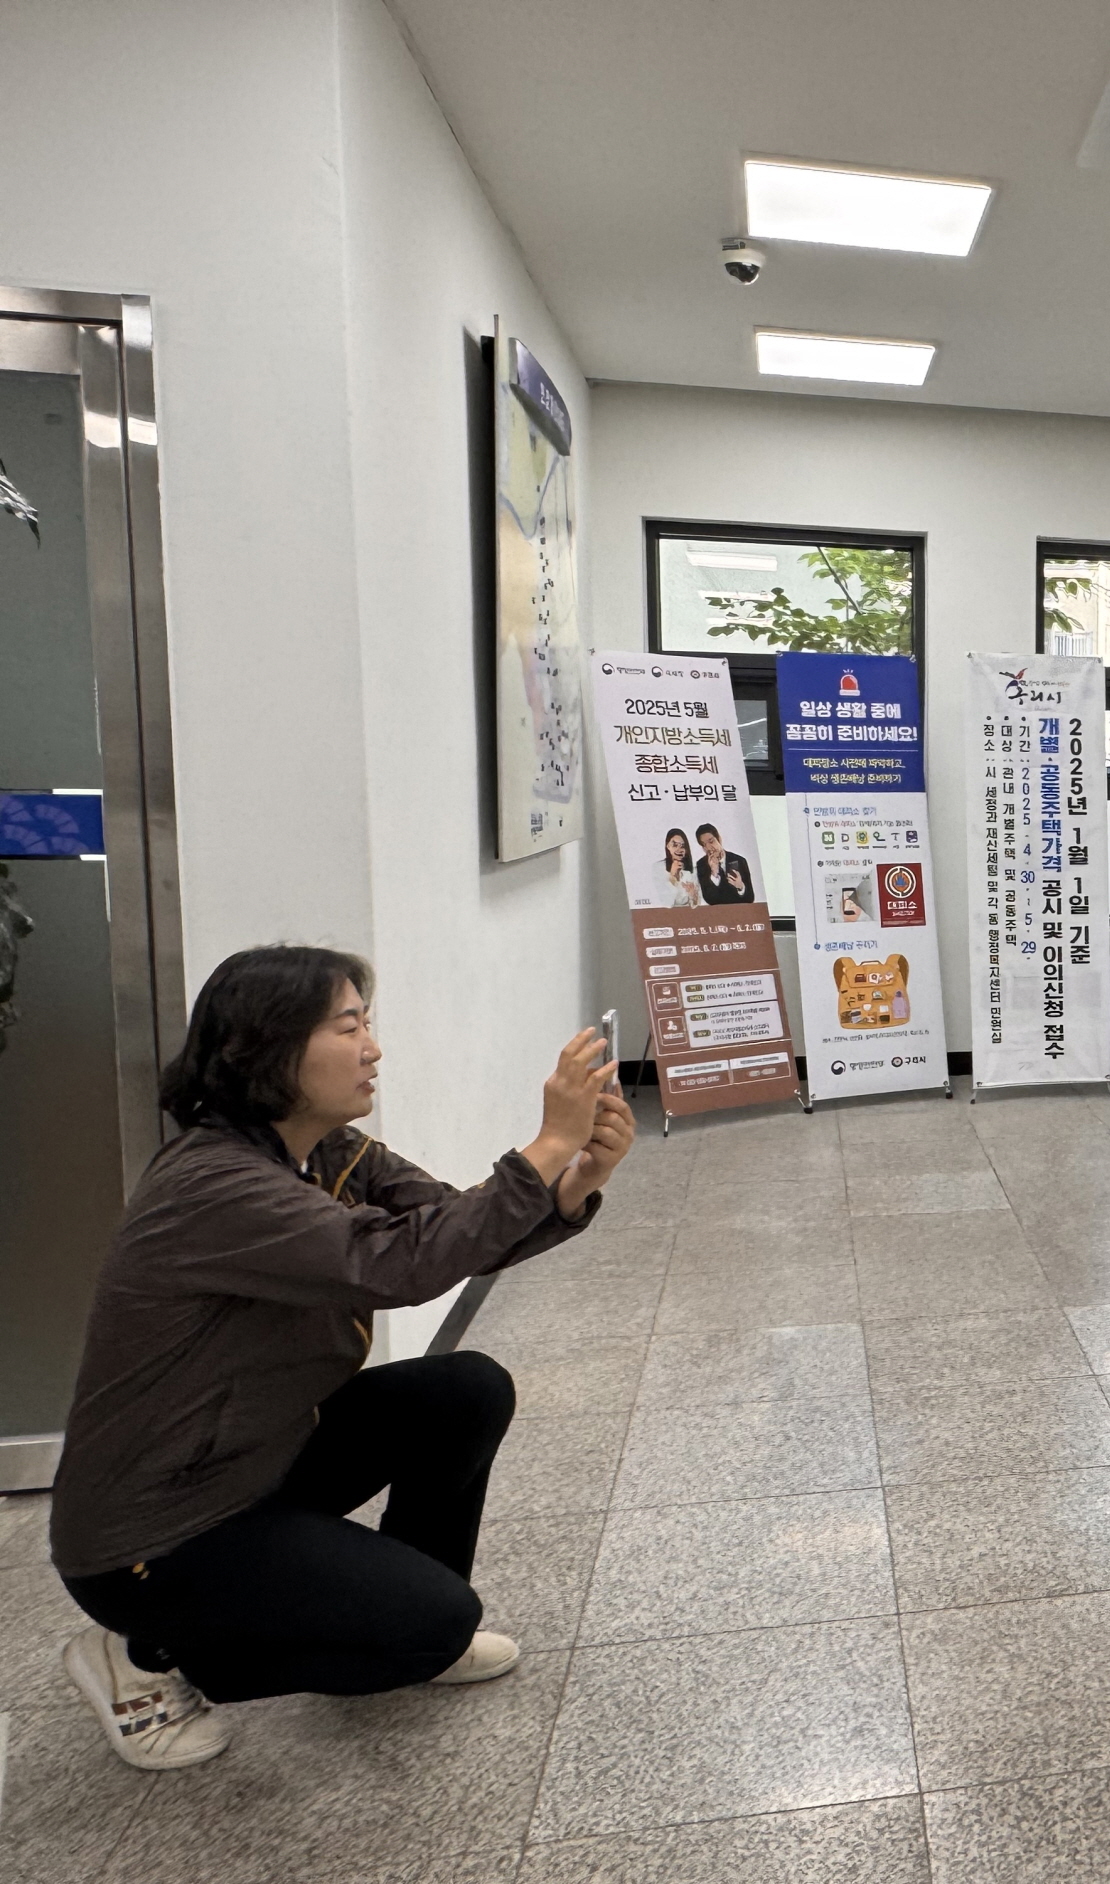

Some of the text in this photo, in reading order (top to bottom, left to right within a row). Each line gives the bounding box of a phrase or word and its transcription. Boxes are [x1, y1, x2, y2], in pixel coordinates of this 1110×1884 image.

[625, 699, 709, 718] 2025년 5월
[800, 701, 901, 719] 일상 생활 중에
[614, 725, 732, 747] 개인지방소득세
[785, 724, 918, 742] 꼼꼼히 준비하세요!
[635, 754, 719, 774] 종합소득세
[985, 767, 996, 778] 시
[722, 784, 737, 802] 달
[1068, 718, 1091, 965] 2025년 1월 1일 기준
[1042, 880, 1062, 915] 공시
[1042, 922, 1063, 939] 및
[1043, 946, 1064, 1018] 이의신청
[1044, 1024, 1065, 1059] 접수
